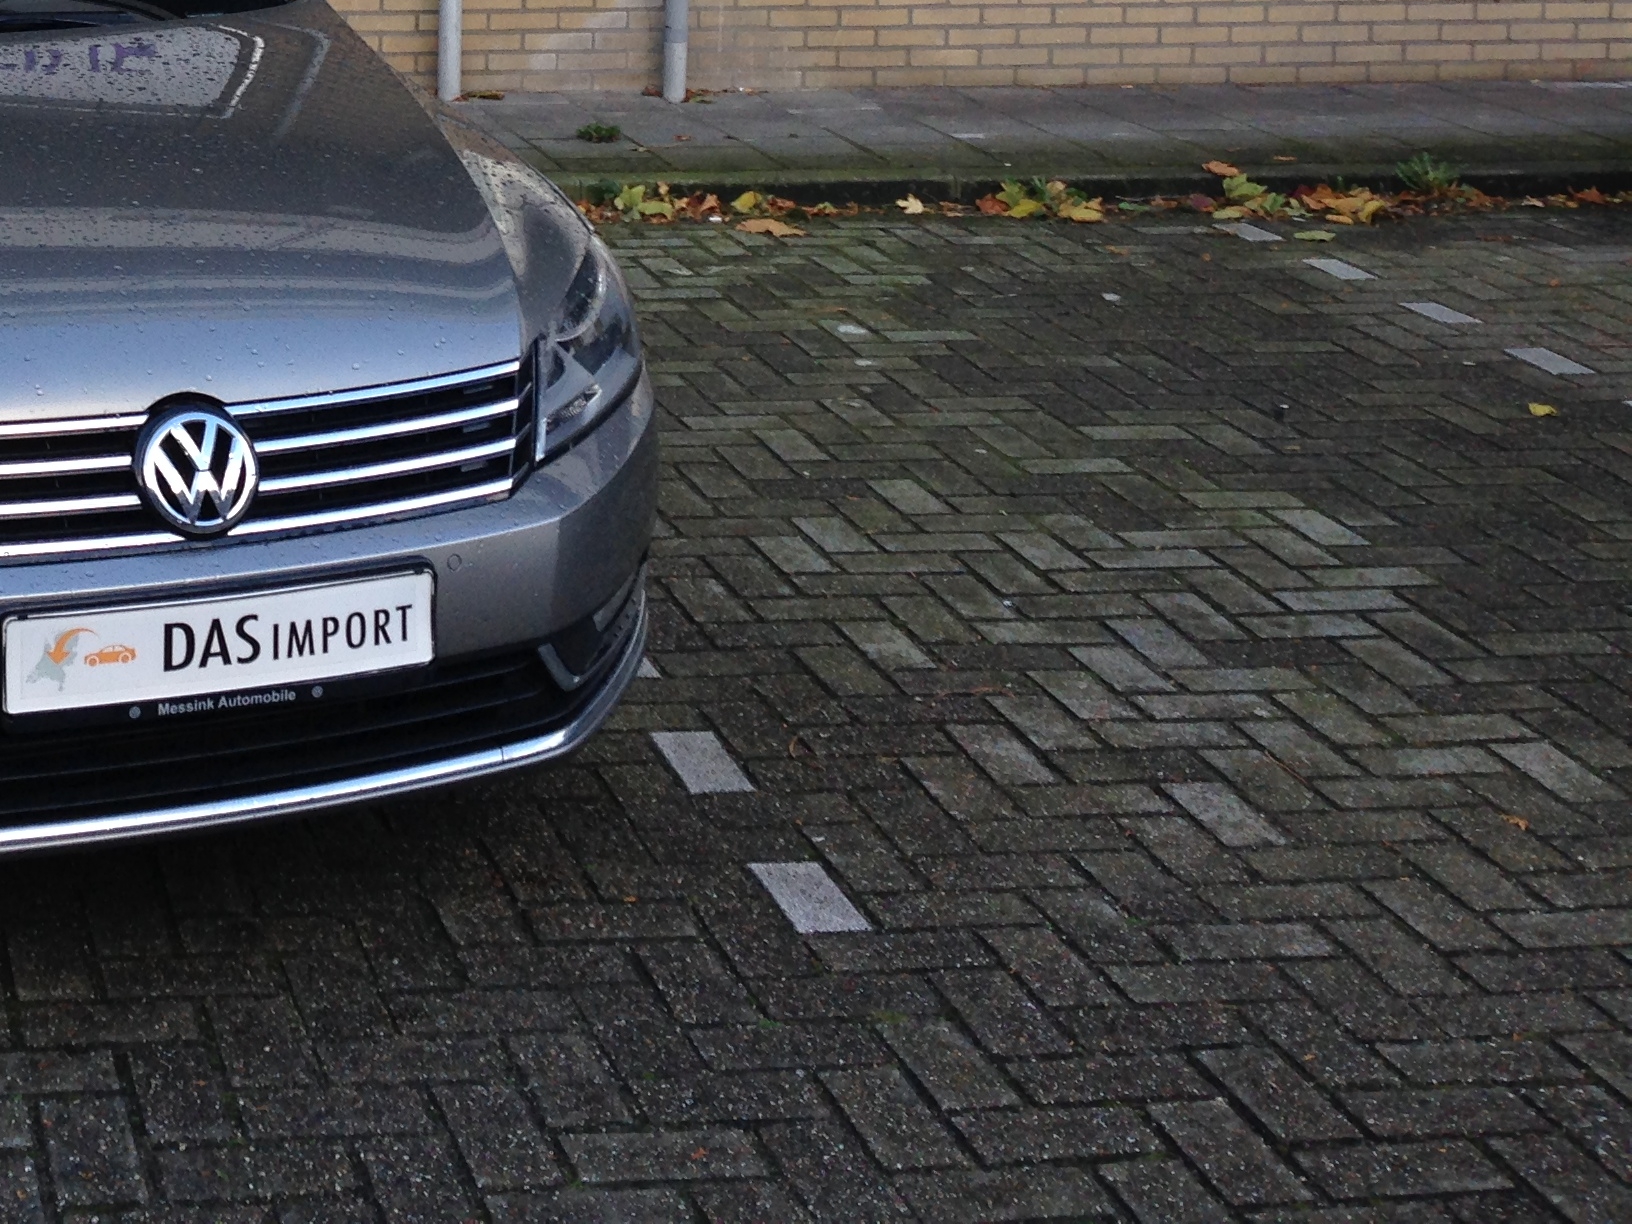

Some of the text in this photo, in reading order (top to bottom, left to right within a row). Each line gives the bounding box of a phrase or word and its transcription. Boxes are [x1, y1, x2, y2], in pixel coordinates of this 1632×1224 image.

[163, 604, 413, 672] DAS IMPORT
[157, 688, 297, 716] Messink Automobile
